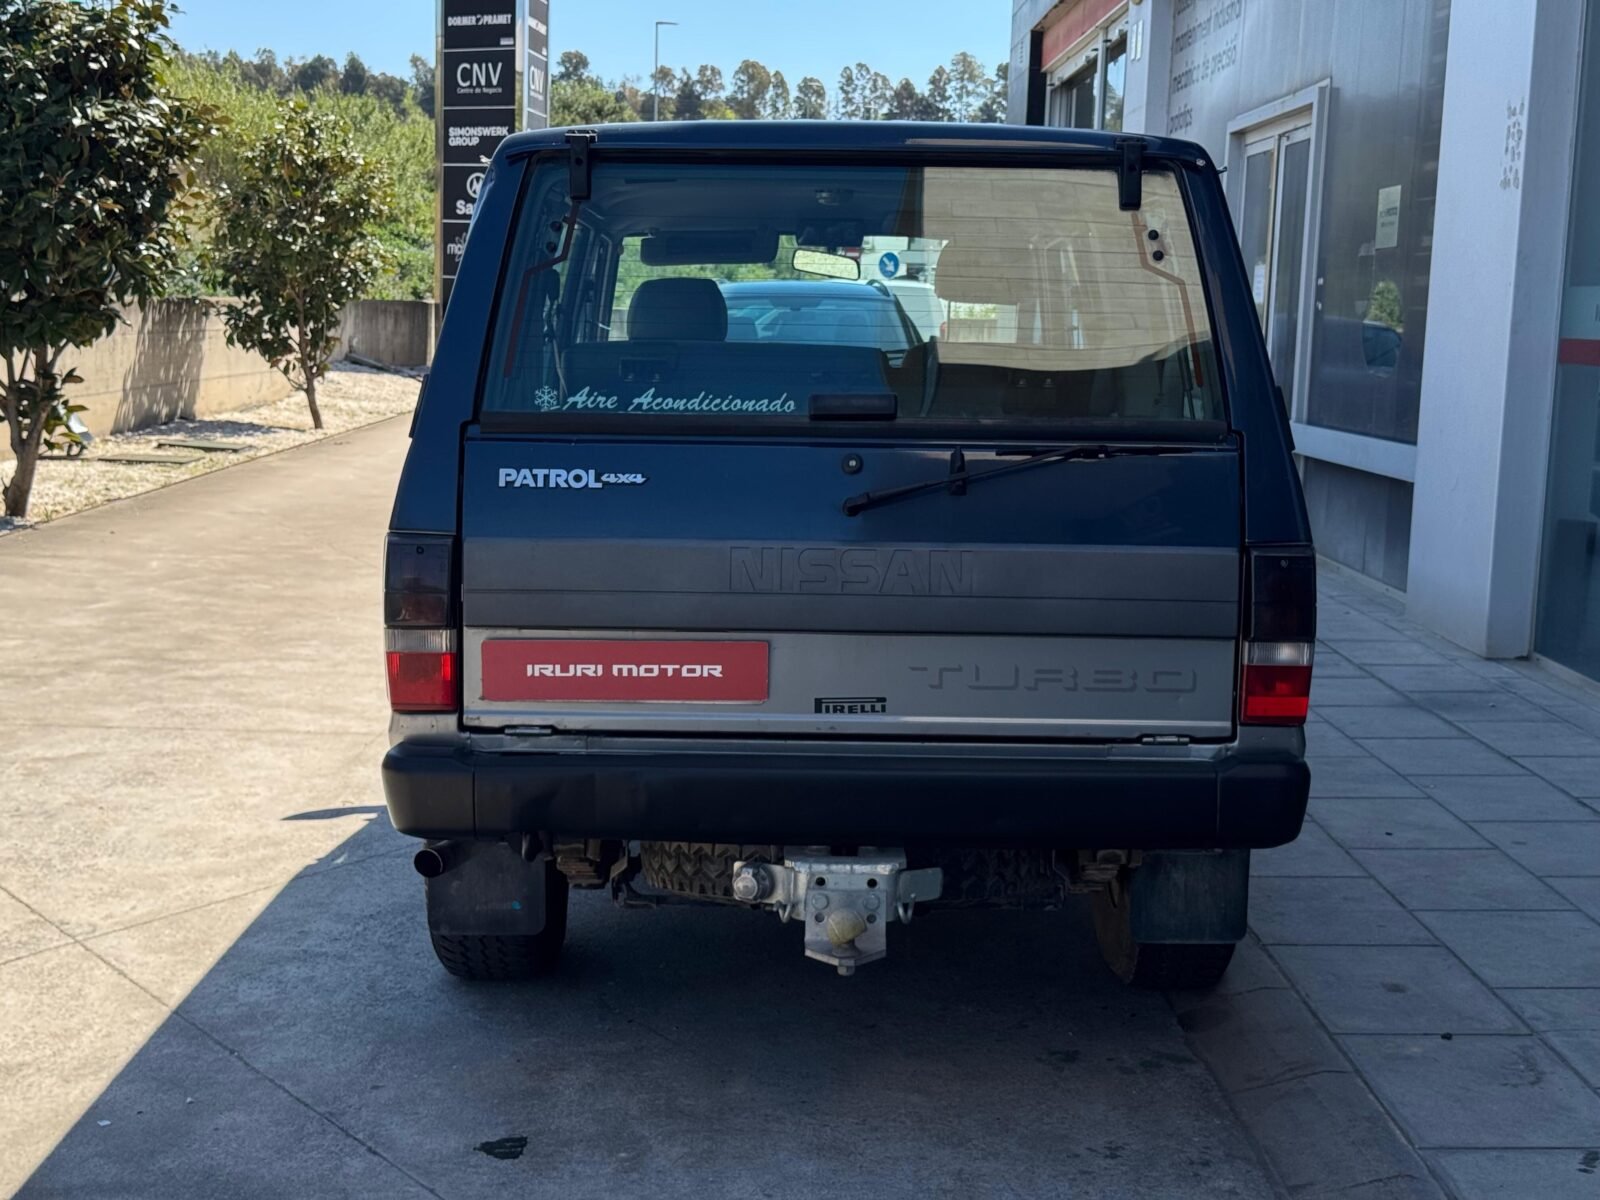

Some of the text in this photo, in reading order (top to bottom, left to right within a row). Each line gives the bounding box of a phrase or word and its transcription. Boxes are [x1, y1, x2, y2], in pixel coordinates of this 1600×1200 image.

[483, 13, 512, 25] PRAMET
[456, 62, 503, 88] CNV
[448, 126, 509, 138] SIMONSWERK
[448, 136, 480, 147] GROUP
[455, 199, 474, 215] Sa
[562, 385, 796, 414] Aire Acondicionado
[498, 467, 647, 489] PATROL 4x4
[728, 546, 974, 594] NISSAN
[526, 663, 723, 678] IRURI MOTOR
[907, 663, 1199, 694] TURBO
[813, 696, 887, 714] PIRELLI
